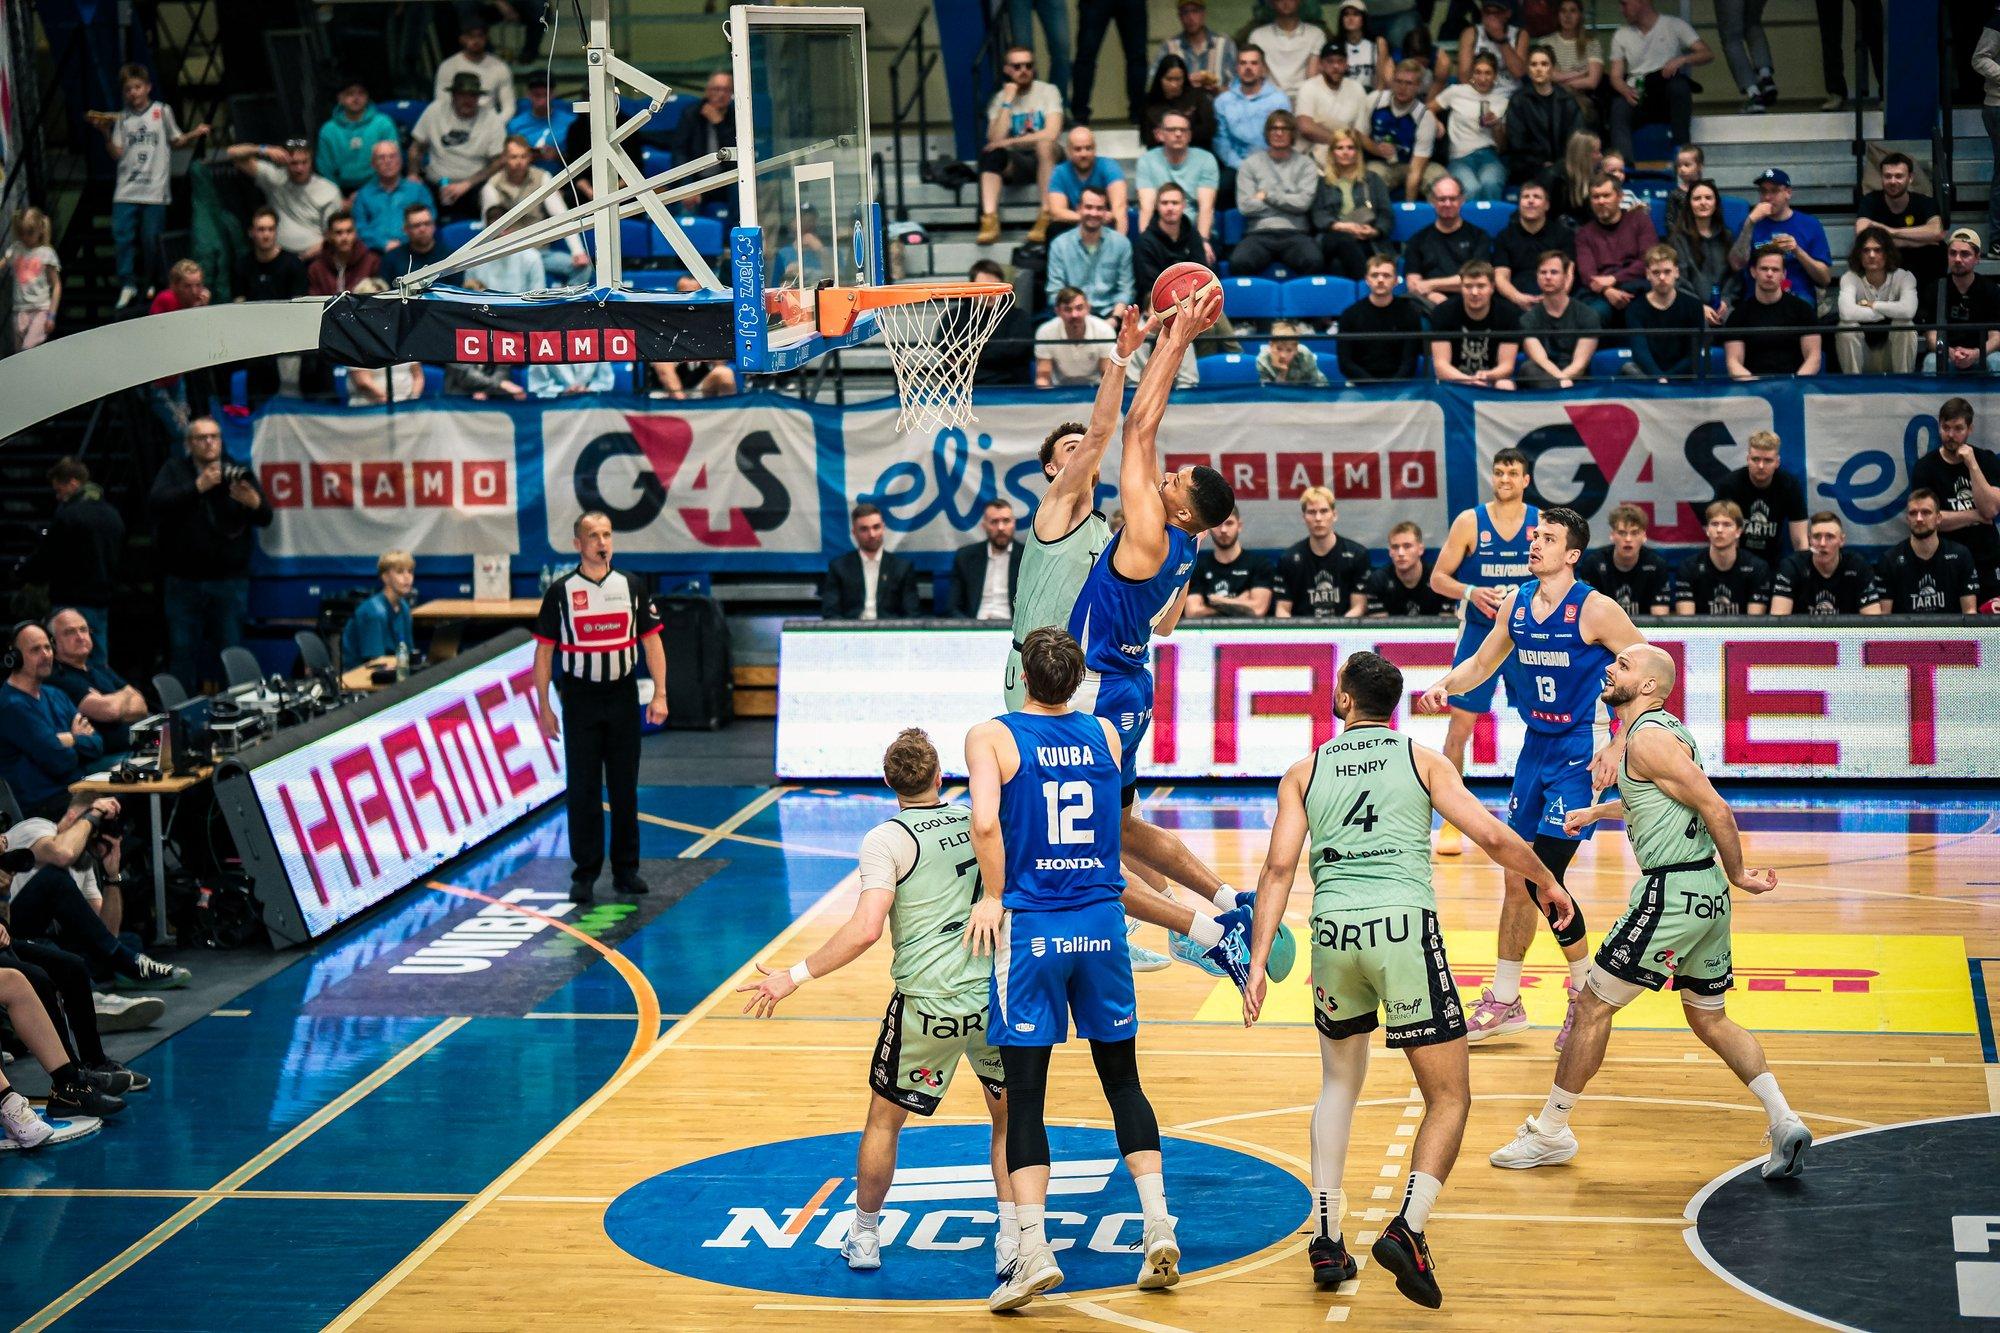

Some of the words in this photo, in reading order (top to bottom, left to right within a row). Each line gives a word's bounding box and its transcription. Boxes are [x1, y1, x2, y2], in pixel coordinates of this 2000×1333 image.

[464, 336, 628, 357] CRAMO
[271, 469, 496, 500] CRAMO
[574, 414, 792, 547] G4S
[1178, 461, 1426, 491] RAMO
[1307, 586, 1340, 605] TARTU
[1910, 592, 1946, 610] TARTU
[595, 623, 621, 635] Optibet
[1535, 676, 1556, 703] 13
[1036, 745, 1095, 766] KUUBA
[1336, 759, 1388, 777] HENRY
[1042, 780, 1095, 845] 12
[1342, 790, 1378, 832] 4
[1035, 857, 1105, 870] HONDA
[955, 857, 984, 905] 7
[387, 888, 578, 974] UNIBET
[1051, 936, 1111, 954] Tallinn
[909, 1067, 944, 1088] G4S
